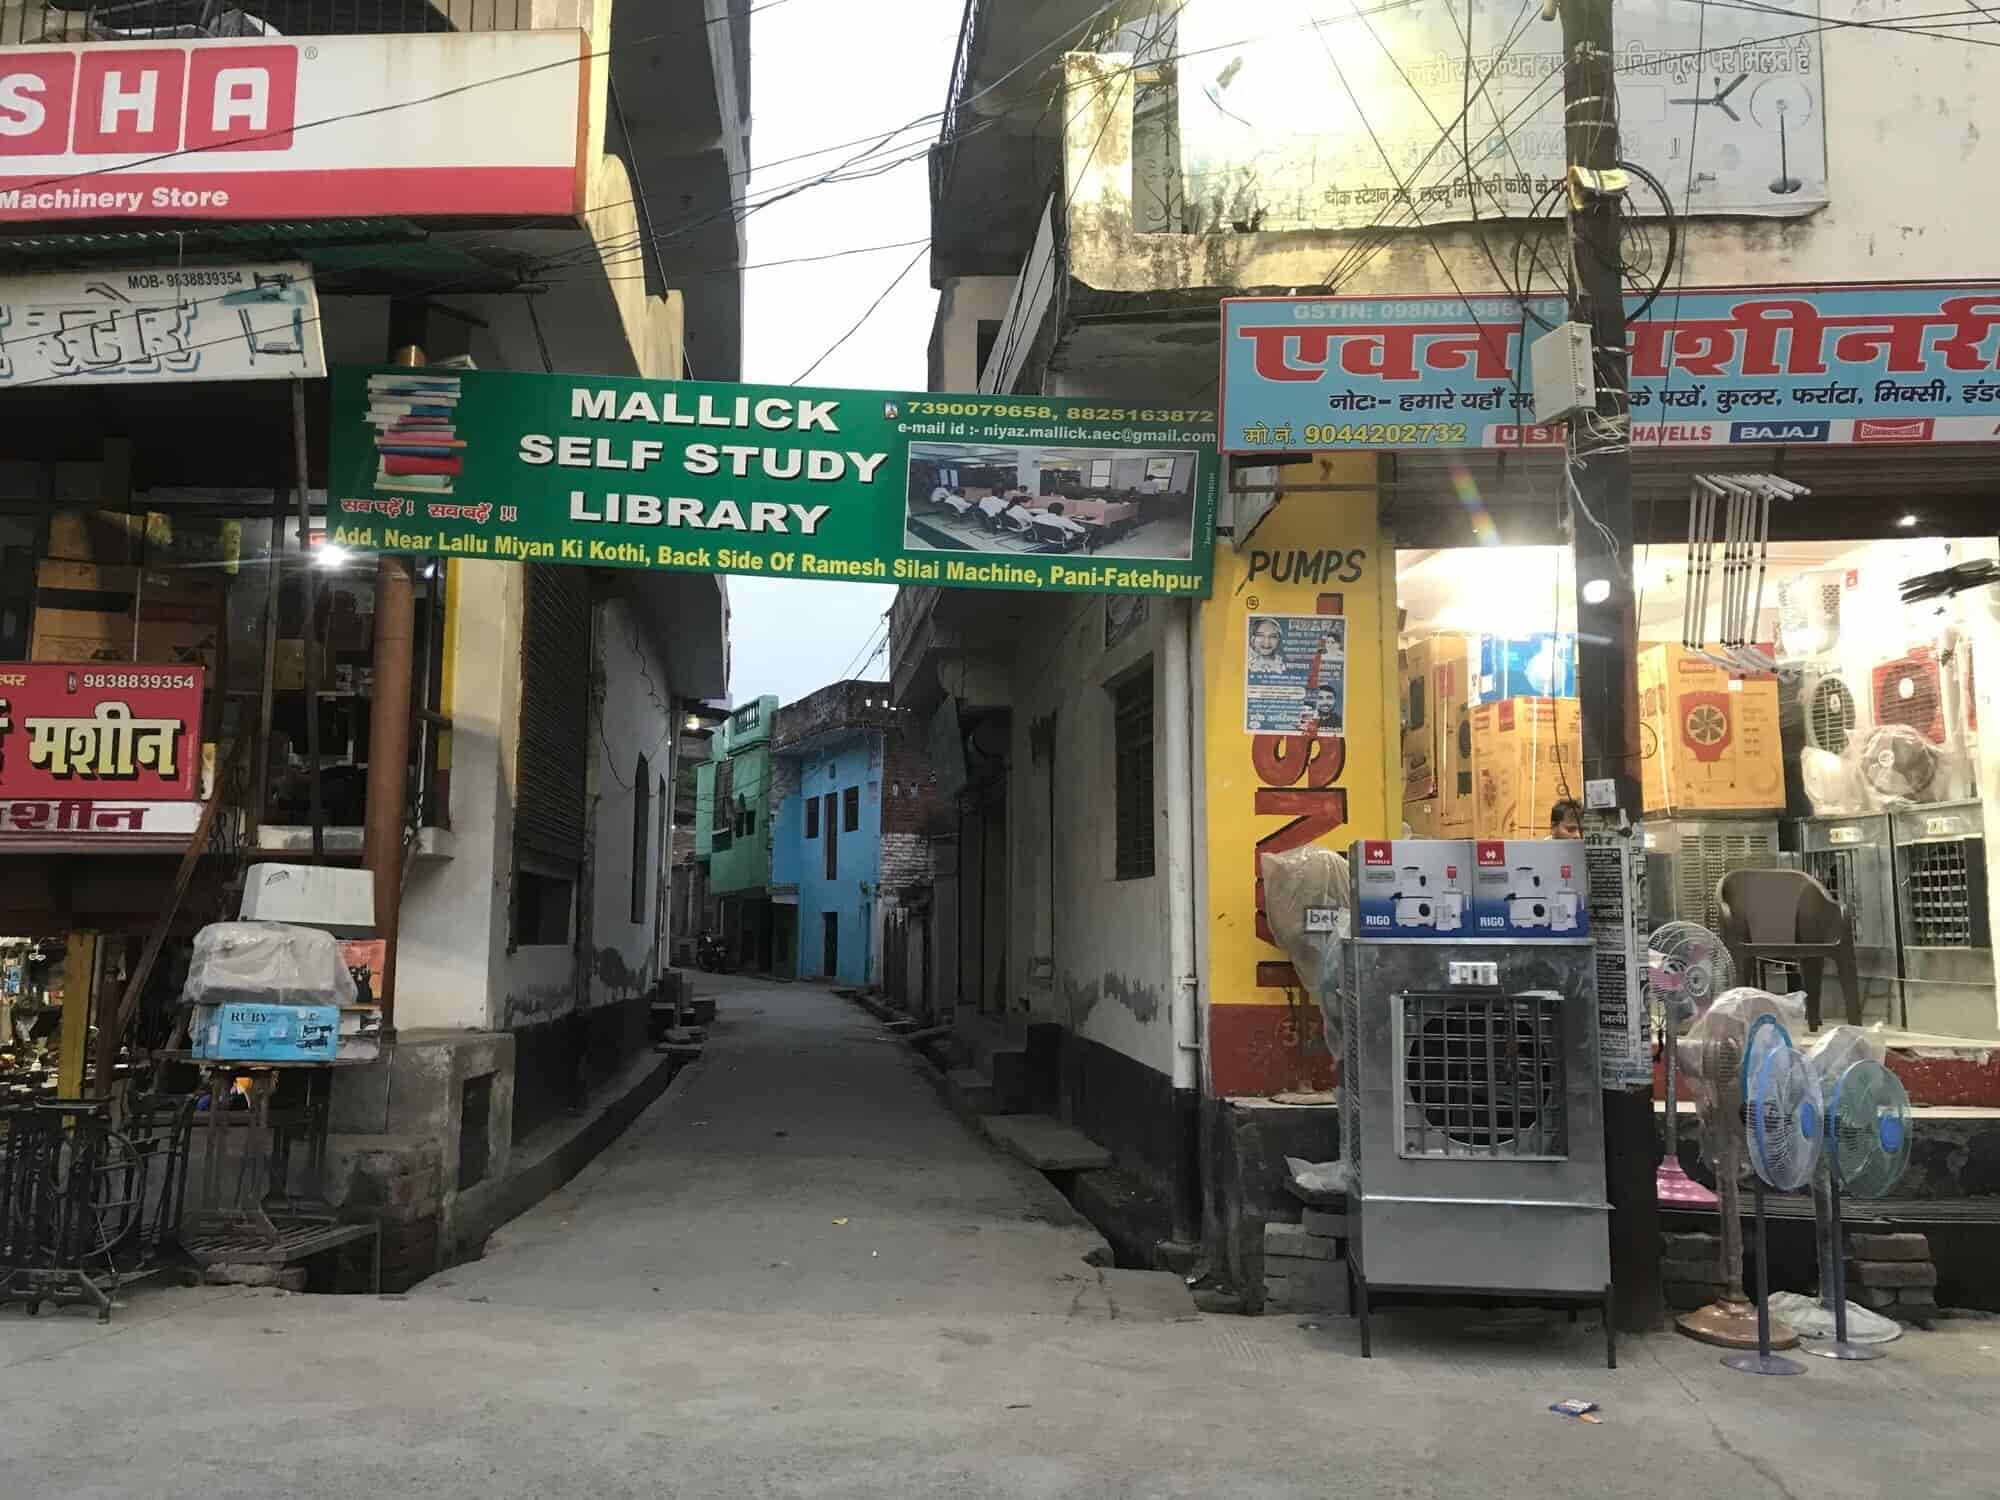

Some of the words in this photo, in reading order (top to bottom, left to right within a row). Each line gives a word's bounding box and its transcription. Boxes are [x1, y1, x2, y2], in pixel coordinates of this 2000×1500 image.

[0, 188, 144, 212] Machinery
[151, 186, 229, 208] Store
[1294, 303, 1373, 320] GSTIN:
[571, 388, 840, 432] MALLICK
[1399, 387, 1456, 411] हमारे
[1717, 388, 1782, 413] कुलर,
[907, 401, 1058, 422] 7390079658,
[1066, 407, 1215, 423] 8825163872
[898, 421, 946, 436] e-mail
[950, 423, 965, 436] id
[984, 424, 1216, 444] niyaz.mallick.aec@gmail.com
[1304, 423, 1466, 443] 9044202732
[1632, 425, 1712, 441] HAVELLS
[1740, 426, 1818, 439] BAJAJ
[519, 434, 664, 471] SELF
[683, 443, 888, 482] STUDY
[570, 491, 831, 535] LIBRARY
[335, 526, 377, 546] Add.
[384, 530, 433, 549] Near
[439, 532, 489, 553] Lallu
[495, 536, 554, 560] Miyan
[561, 539, 583, 559] Ki
[589, 541, 650, 566] Kothi,
[658, 546, 711, 567] Back
[718, 549, 763, 570] Side
[770, 552, 795, 571] Of
[801, 554, 886, 577] Ramesh
[893, 558, 940, 580] Silai
[947, 560, 1043, 588] Machine,
[1050, 566, 1203, 593] Pani-Fatehpur
[1249, 549, 1366, 584] PUMPS
[83, 674, 194, 689] 9838839354
[25, 701, 182, 776] मशीन
[1365, 915, 1390, 926] RIGO
[1480, 916, 1504, 927] RIGO
